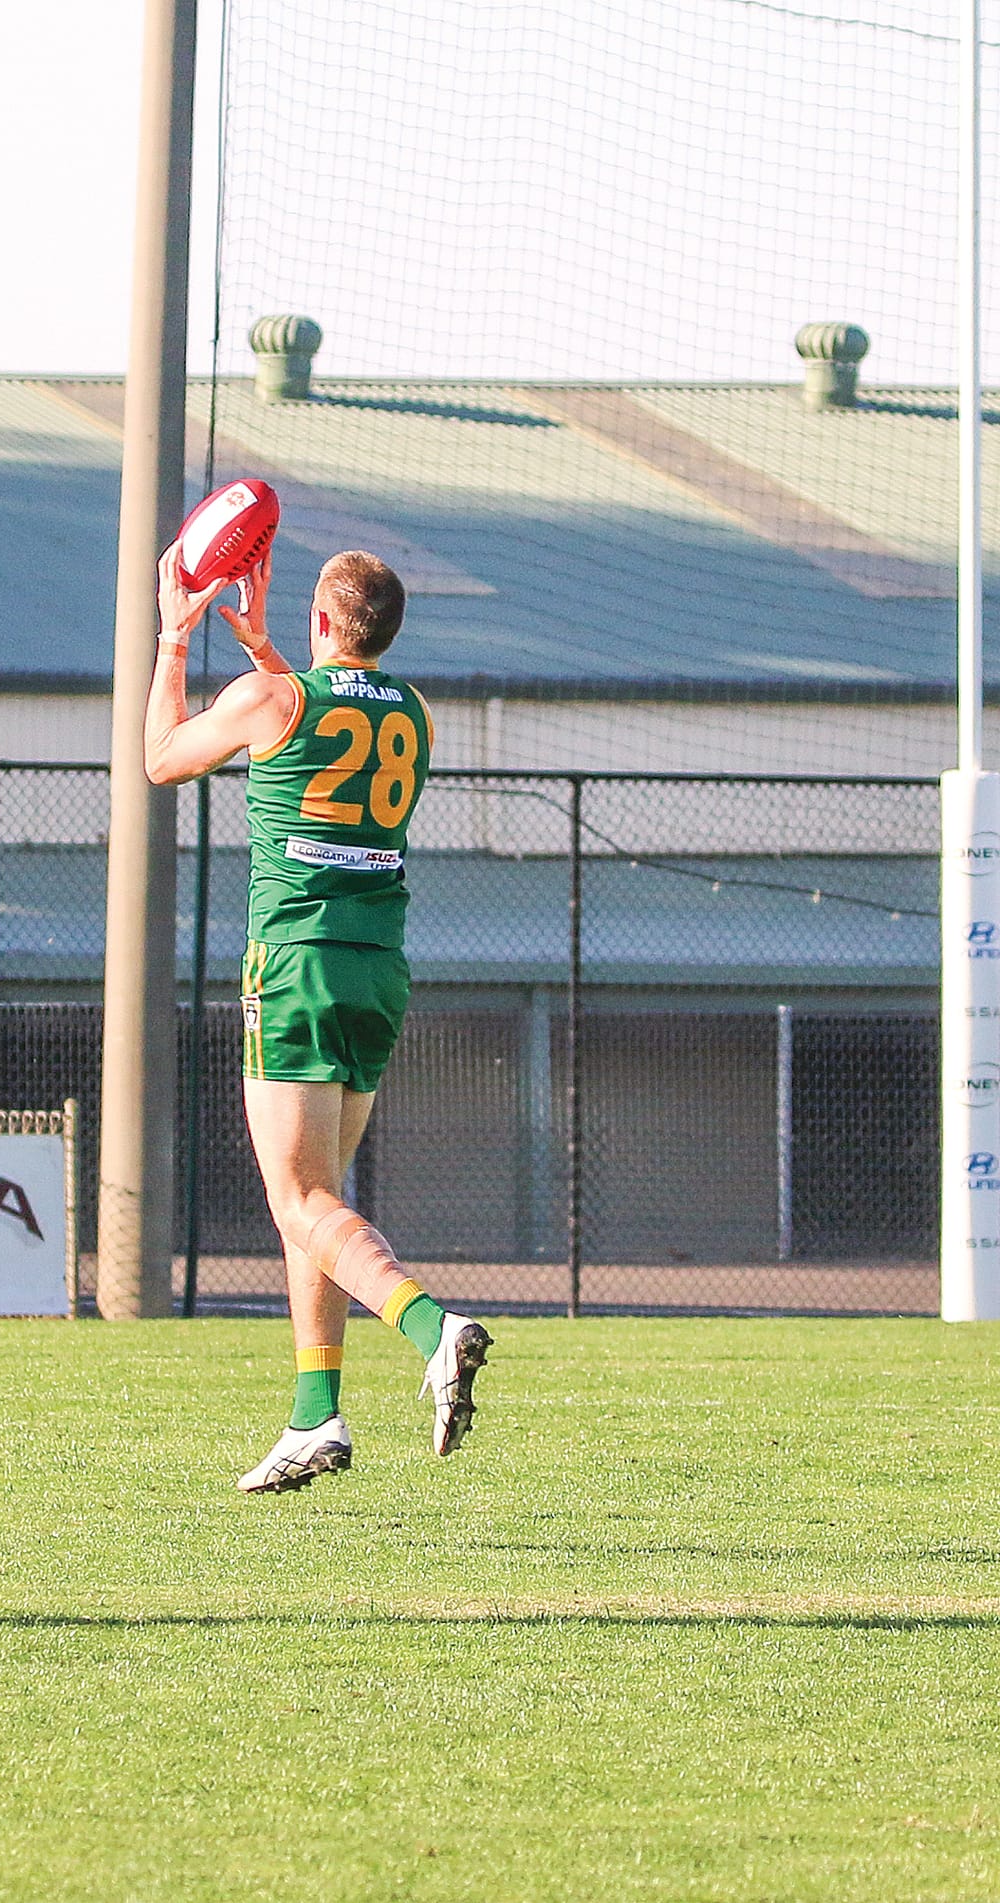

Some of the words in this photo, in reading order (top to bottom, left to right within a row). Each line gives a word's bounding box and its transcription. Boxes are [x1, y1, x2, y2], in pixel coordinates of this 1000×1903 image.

[325, 669, 367, 684] TAFE
[330, 682, 403, 702] GIPPSLAND
[300, 706, 418, 829] 28
[292, 844, 356, 864] LEONGATHA
